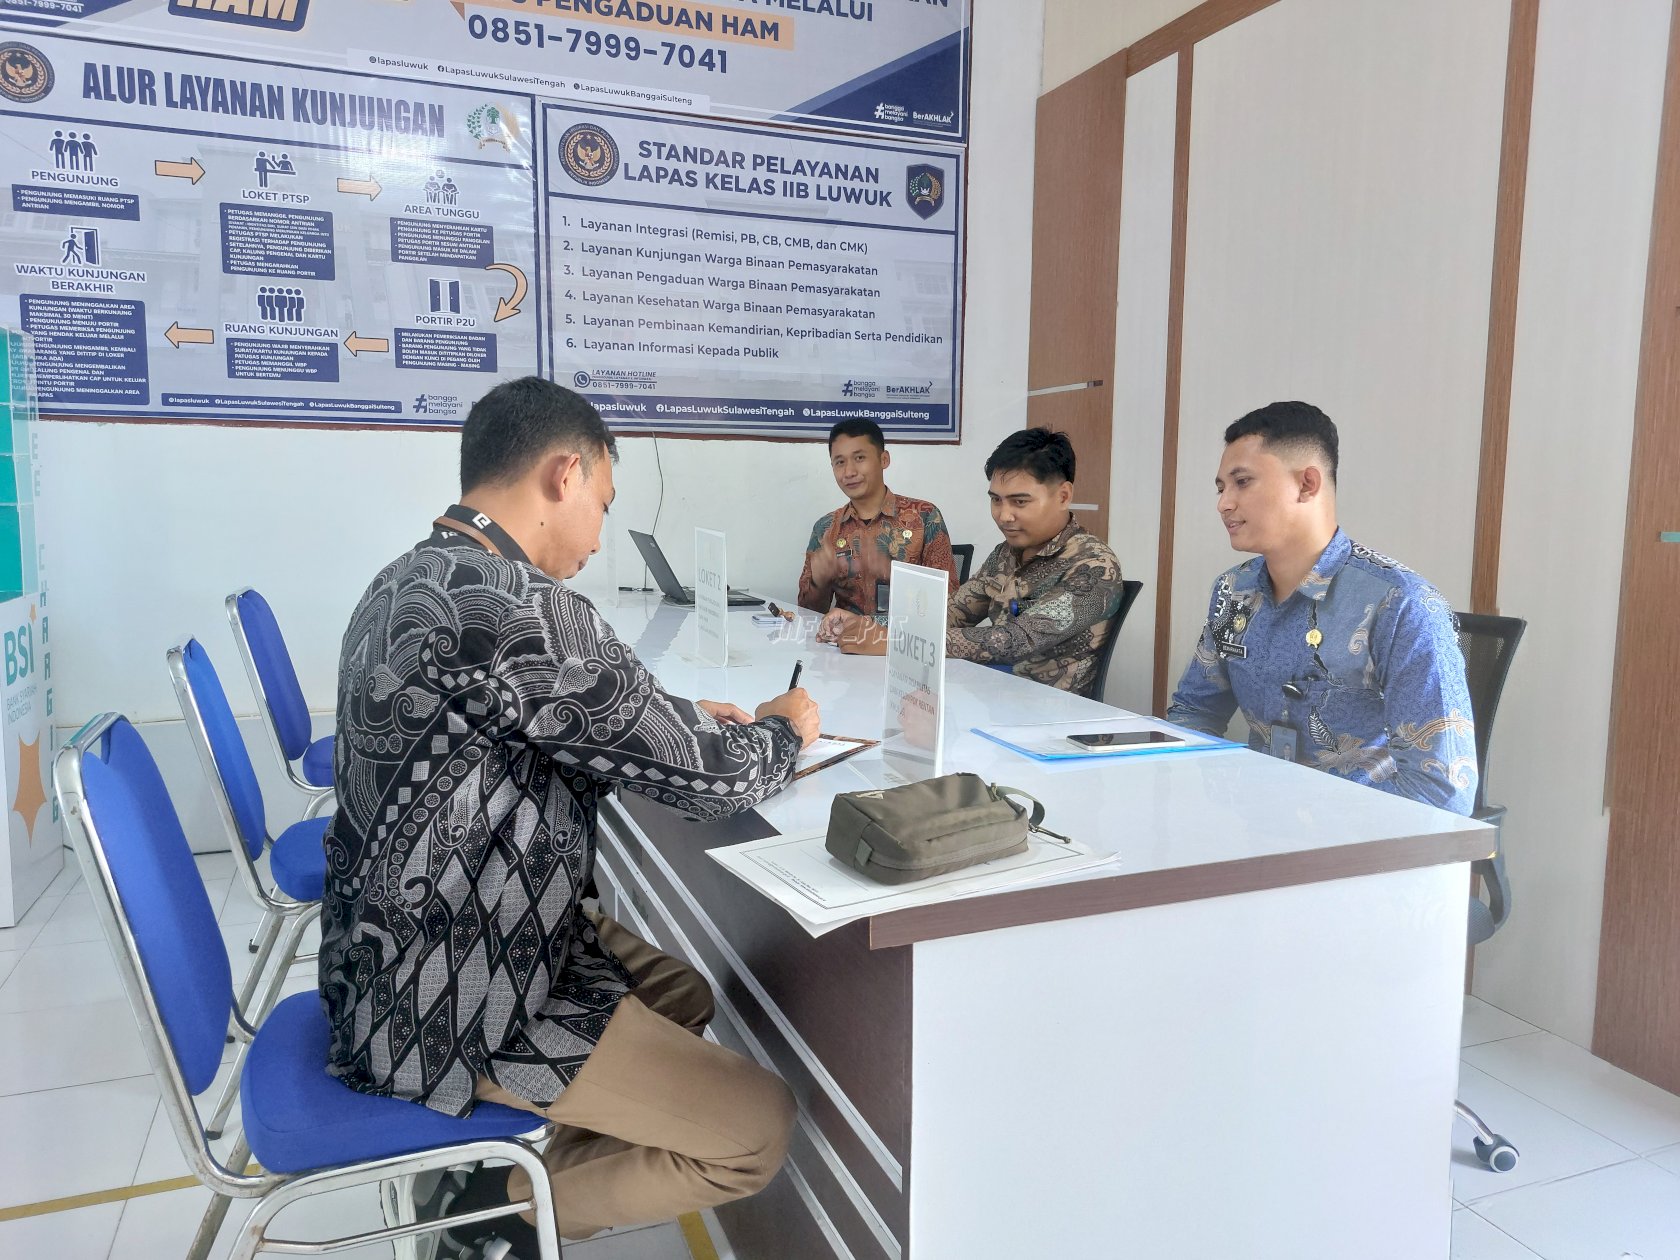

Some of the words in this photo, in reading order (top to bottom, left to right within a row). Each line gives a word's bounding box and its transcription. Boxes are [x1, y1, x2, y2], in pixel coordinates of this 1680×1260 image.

[722, 14, 779, 42] HAM
[468, 14, 728, 74] 0851-7999-7041
[378, 57, 428, 70] lapasluwuk
[445, 65, 566, 89] LapasLuwukSulawesiTengah
[82, 62, 158, 104] ALUR
[164, 72, 286, 121] LAYANAN
[292, 88, 445, 138] KUNJUNGAN
[580, 83, 693, 105] LapasLuwukBanggaiSulteng
[912, 112, 952, 123] BerAKHLAK
[638, 140, 746, 170] STANDAR
[752, 155, 880, 184] PELAYANAN
[32, 170, 118, 186] PENGUNJUNG
[624, 162, 698, 188] LAPAS
[704, 172, 776, 197] KELAS
[782, 182, 810, 199] IIB
[815, 184, 892, 208] LUWUK
[243, 190, 278, 201] LOKET
[282, 194, 310, 204] PTSP
[404, 205, 432, 215] AREA
[436, 208, 480, 218] TUNGGU
[563, 216, 571, 226] 1.
[580, 218, 632, 232] Layanan
[636, 223, 688, 238] Integrasi
[692, 228, 737, 244] (Remisi,
[741, 234, 760, 246] PB,
[762, 235, 781, 247] CB,
[785, 237, 813, 250] CMB,
[816, 240, 836, 250] dan
[840, 242, 868, 254] CMK)
[563, 240, 574, 251] 2.
[581, 242, 632, 256] Layanan
[636, 248, 701, 263] Kunjungan
[705, 254, 742, 267] Warga
[746, 257, 785, 269] Binaan
[788, 260, 878, 276] Pemasyarakatan
[16, 264, 63, 276] WAKTU
[68, 268, 145, 282] KUNJUNGAN
[564, 265, 574, 275] 3.
[582, 266, 633, 280] Layanan
[637, 271, 704, 286] Pengaduan
[708, 276, 745, 290] Warga
[748, 280, 788, 291] Binaan
[791, 283, 880, 297] Pemasyarakatan
[52, 280, 114, 292] BERAKHIR
[564, 290, 576, 300] 4.
[582, 291, 634, 304] Layanan
[638, 295, 699, 309] Kesehatan
[703, 300, 740, 313] Warga
[744, 302, 782, 313] Binaan
[786, 304, 875, 319] Pemasyarakatan
[225, 324, 265, 334] RUANG
[269, 326, 338, 338] KUNJUNGAN
[416, 316, 453, 326] PORTIR
[456, 318, 475, 327] P2U
[565, 314, 576, 324] 5.
[583, 315, 634, 328] Layanan
[638, 318, 704, 332] Pembinaan
[708, 323, 783, 338] Kemandirian,
[786, 327, 851, 340] Kepribadian
[854, 331, 882, 341] Serta
[885, 332, 943, 344] Pendidikan
[566, 338, 576, 348] 6.
[584, 339, 635, 351] Layanan
[639, 342, 694, 354] Informasi
[698, 345, 740, 357] Kepada
[744, 347, 779, 358] Publik
[428, 394, 457, 402] bangga
[886, 385, 930, 394] BerAKHLAK
[665, 404, 794, 416] LapasLuwukSulawesiTengah
[810, 410, 929, 420] LapasLuwukBanggaiSulteng
[4, 622, 34, 686] BSI
[893, 628, 927, 663] LOKET
[929, 642, 936, 668] 3
